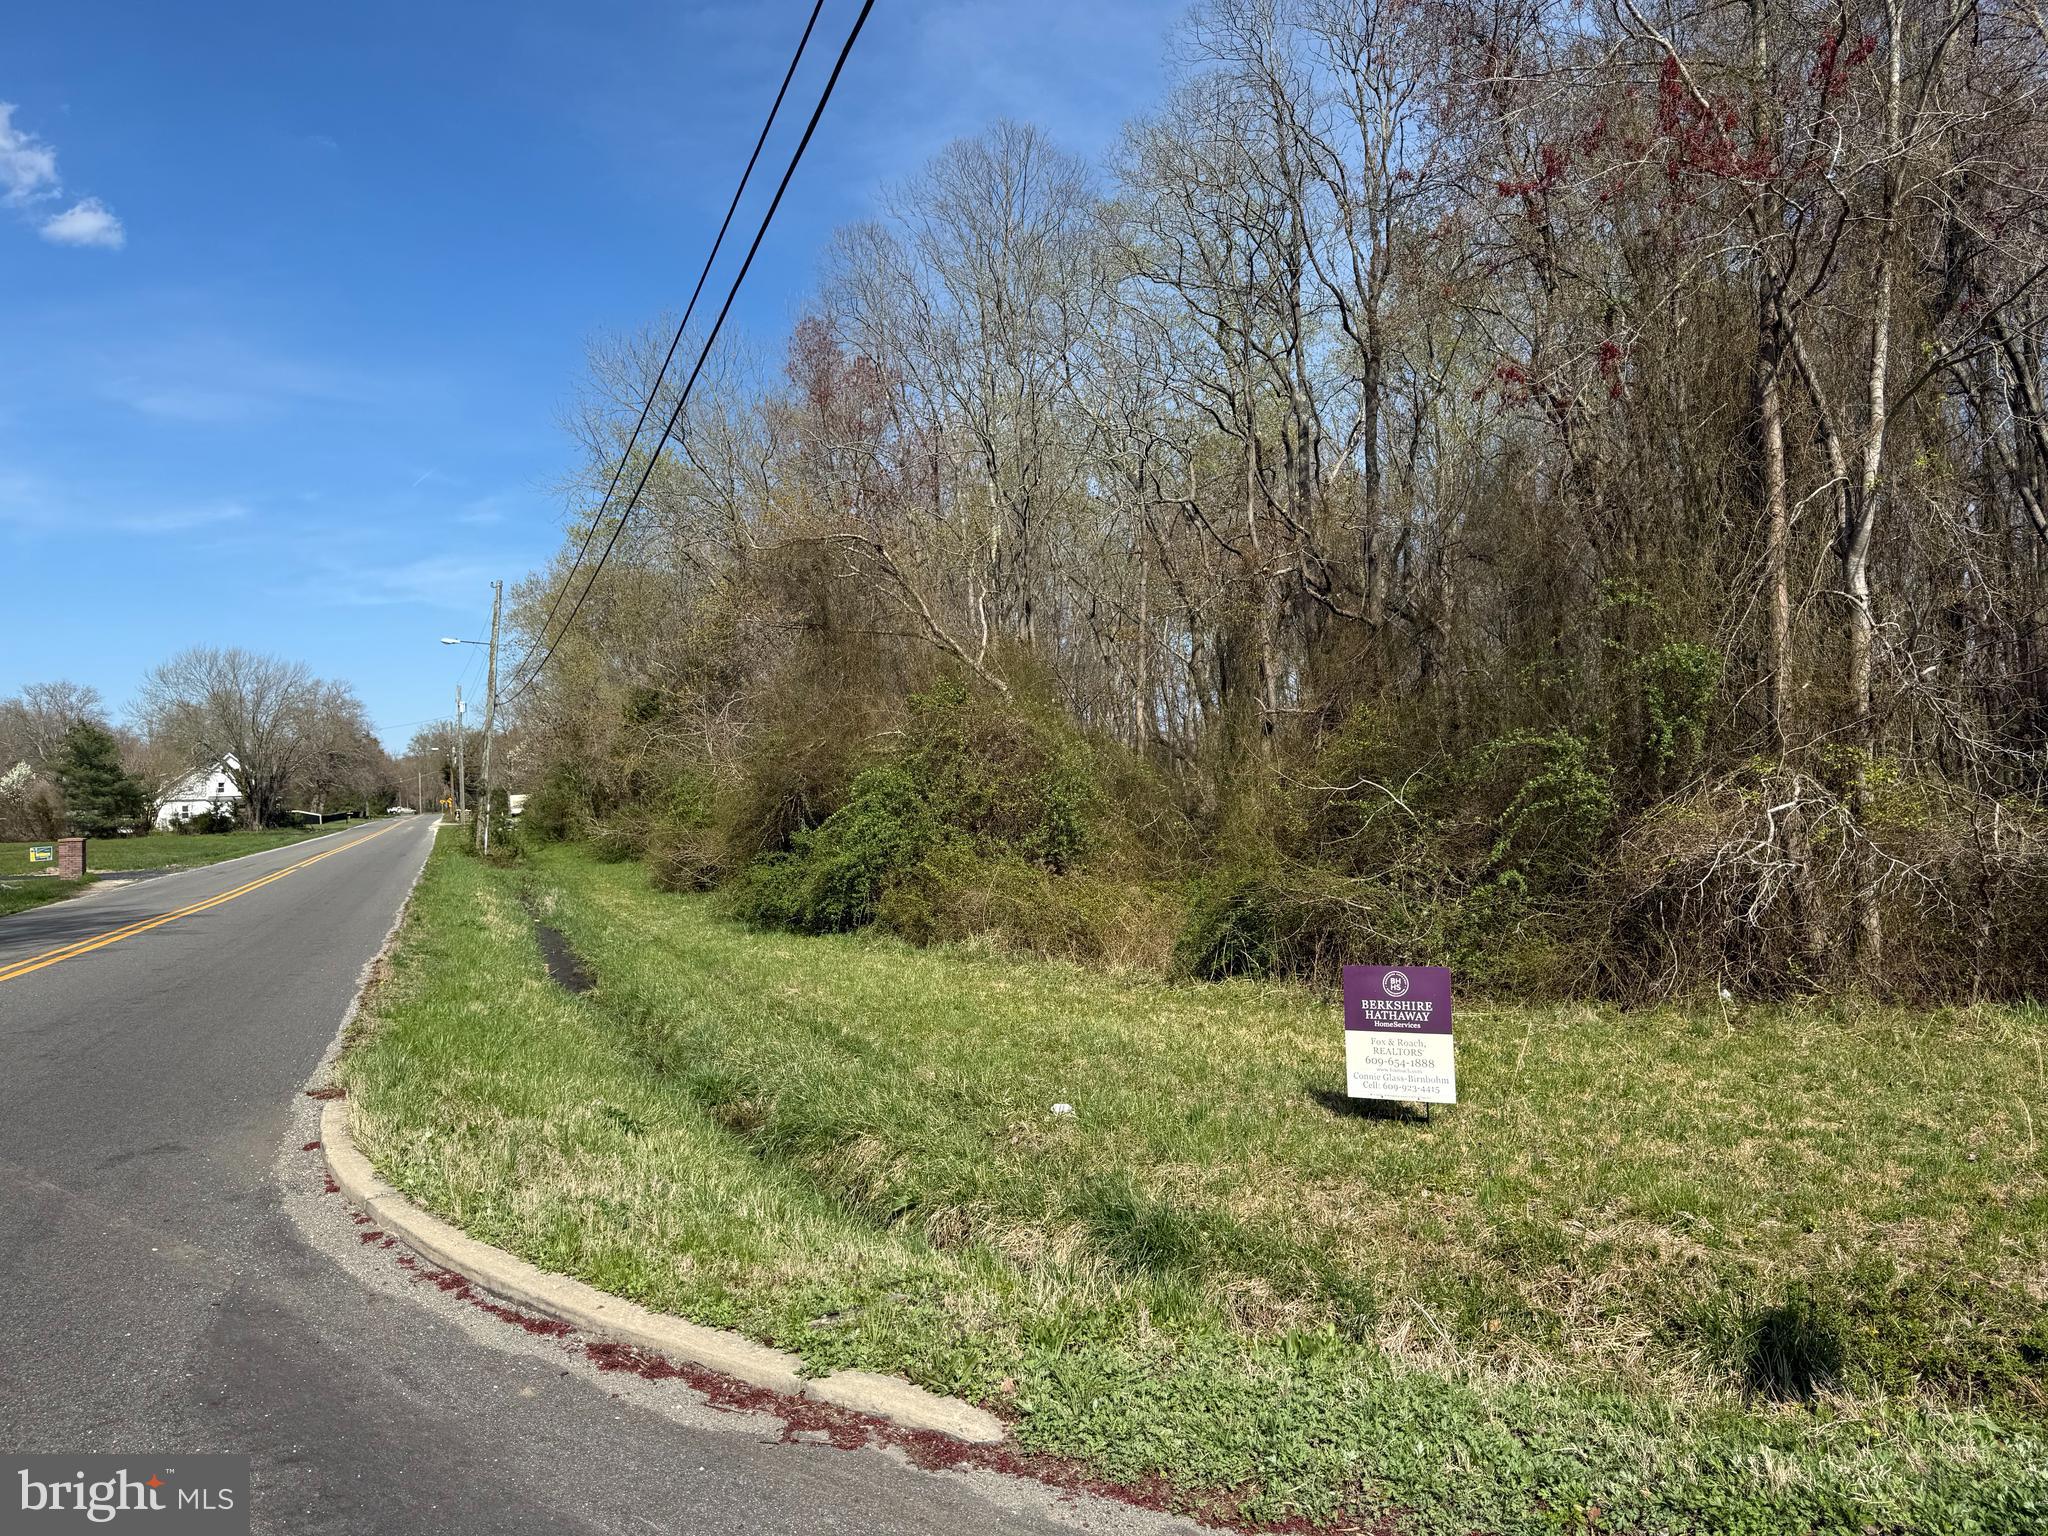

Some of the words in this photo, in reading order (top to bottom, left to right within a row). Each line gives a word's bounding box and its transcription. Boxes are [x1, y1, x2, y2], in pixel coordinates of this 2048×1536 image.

[1361, 999, 1433, 1011] BERKSHIRE
[1365, 1010, 1431, 1021] HATHAWAY
[1374, 1020, 1421, 1029] HomeServices
[1370, 1037, 1386, 1046] Fox
[1388, 1038, 1395, 1046] &
[1397, 1038, 1427, 1048] Roach,
[1365, 1055, 1435, 1068] 609-654-1888
[1353, 1071, 1381, 1080] Connie
[1382, 1073, 1450, 1084] Glass-Birnbohm
